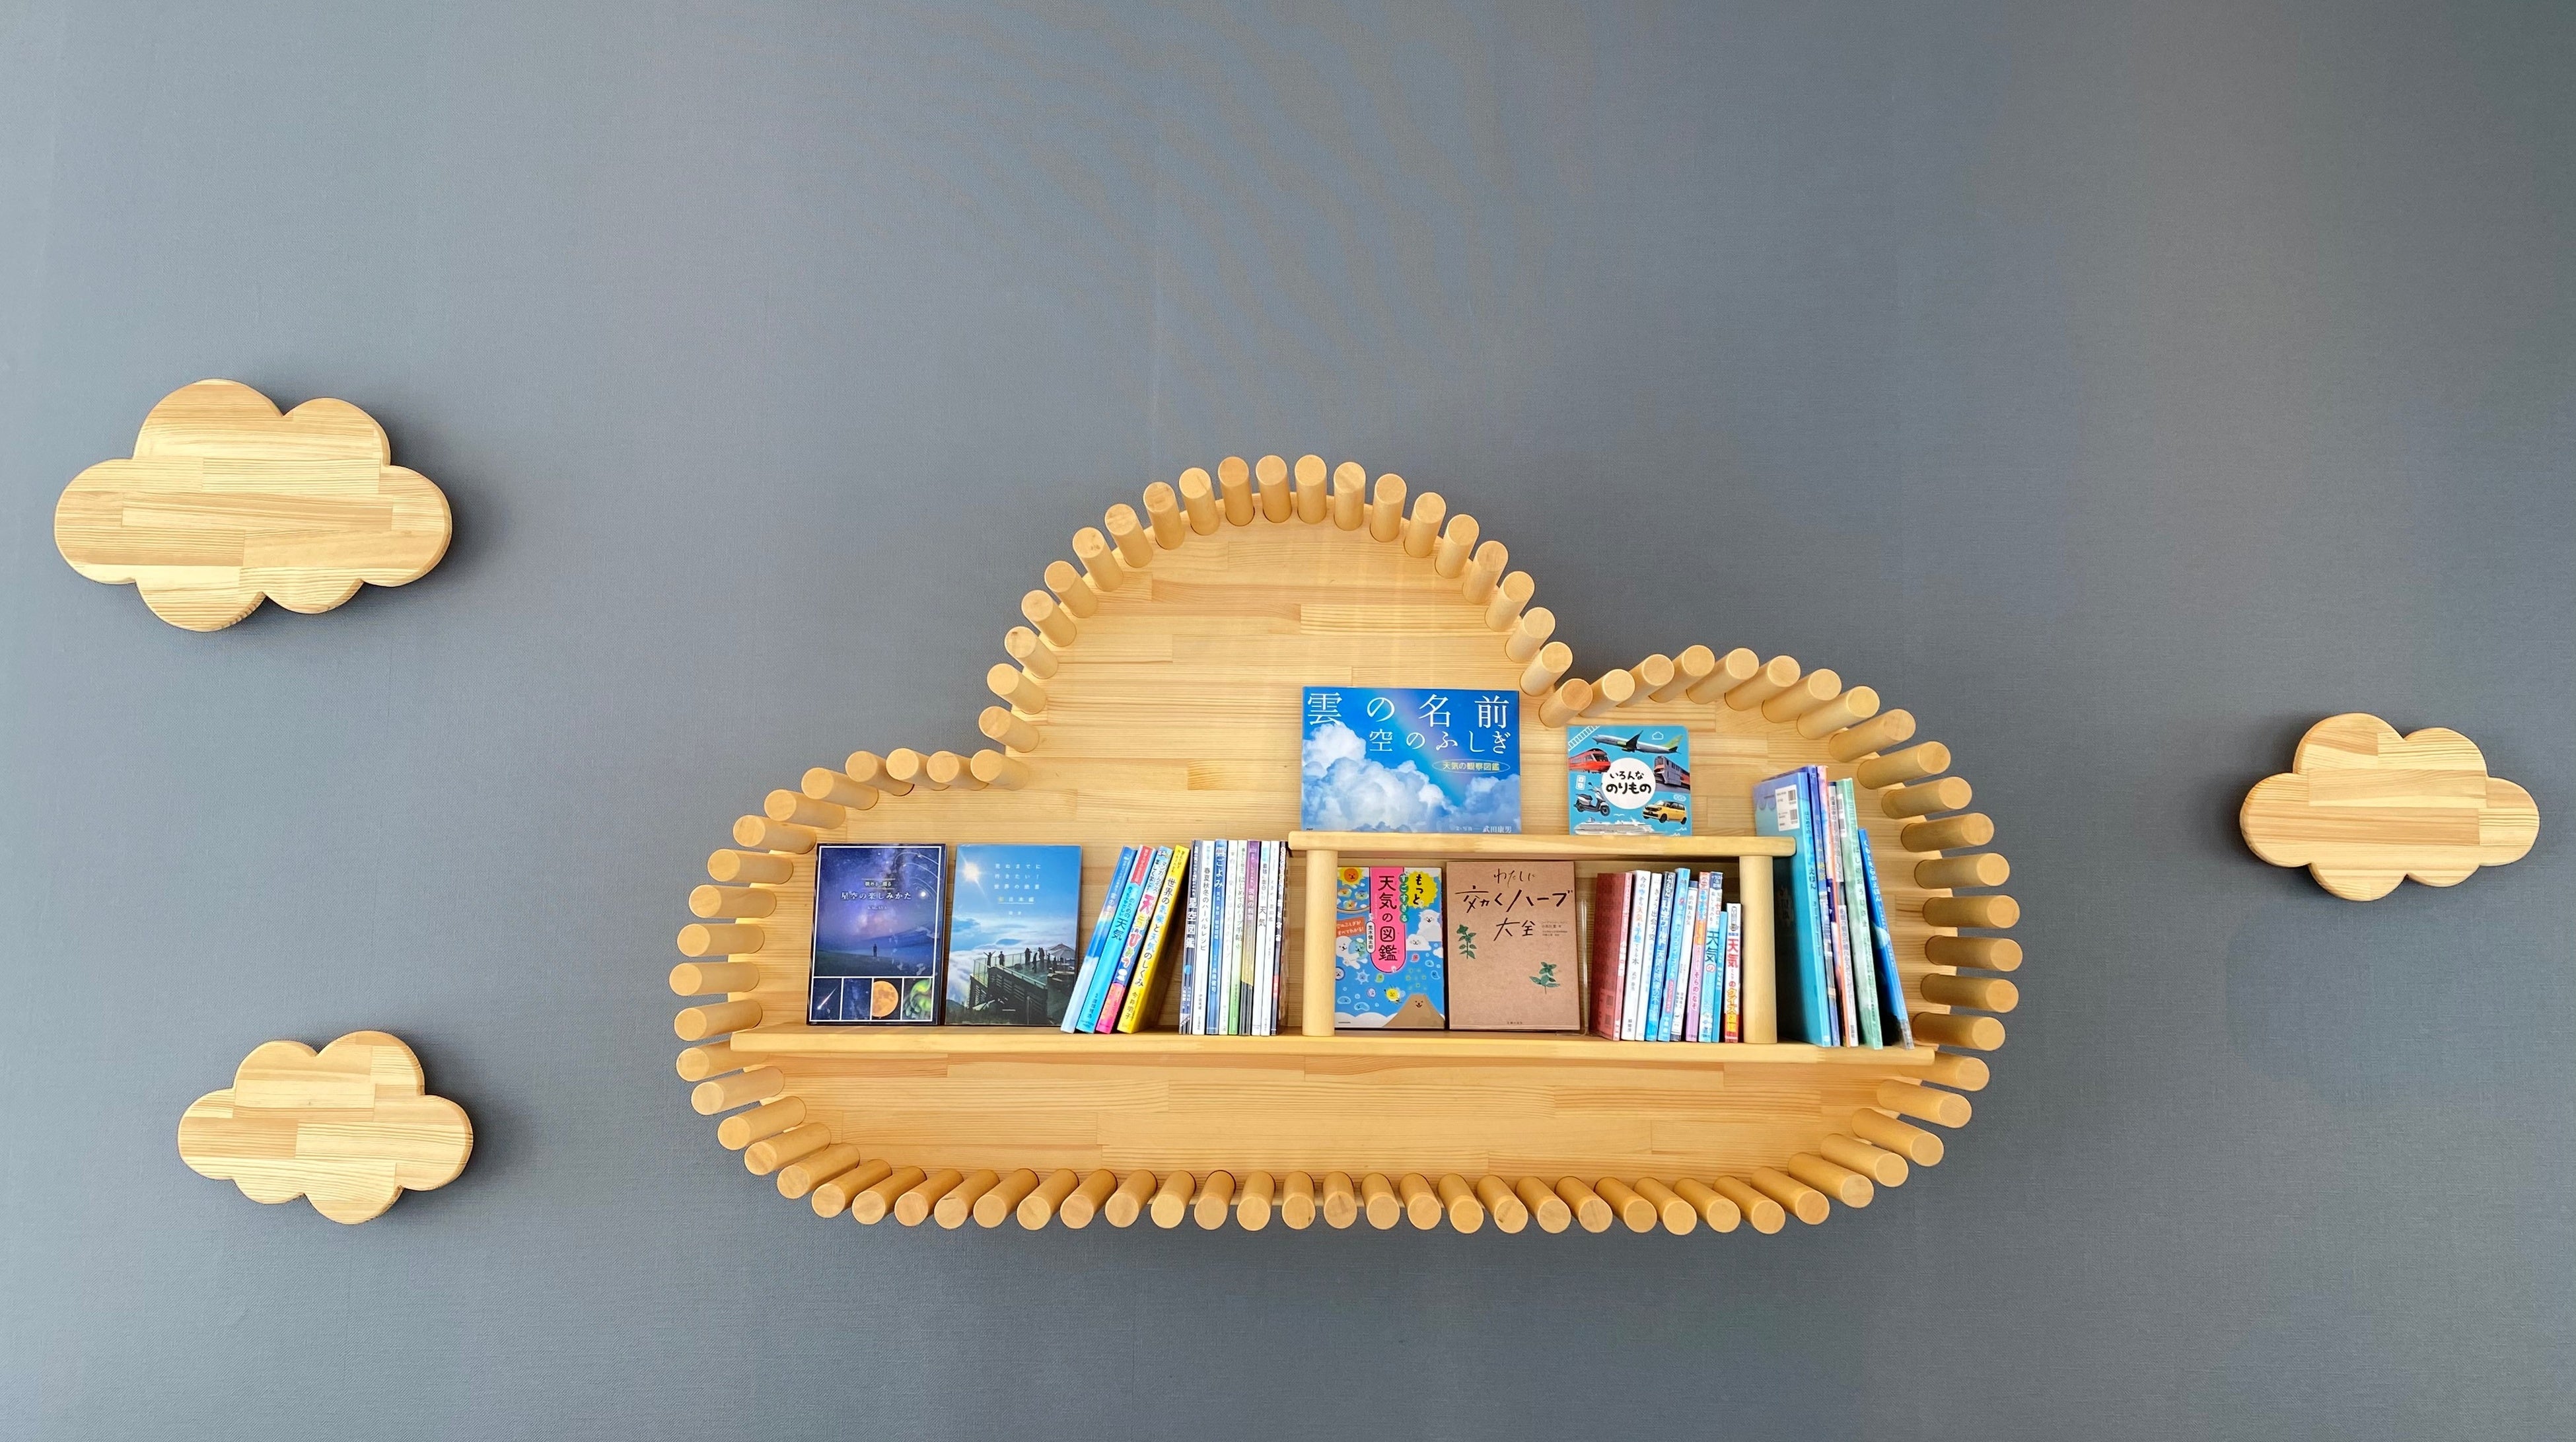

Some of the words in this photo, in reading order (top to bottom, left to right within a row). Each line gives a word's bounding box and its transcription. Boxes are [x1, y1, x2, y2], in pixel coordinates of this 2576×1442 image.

[1307, 692, 1509, 729] 雲の名前
[1369, 729, 1510, 754] 空のふしぎ
[1605, 781, 1651, 795] のりもの
[1610, 770, 1645, 781] いろんな
[1493, 868, 1535, 888] わたしに
[1863, 840, 1881, 902] くもとそらのえほん
[1400, 873, 1409, 923] すごすぎる
[1415, 874, 1424, 905] もっと
[1454, 885, 1573, 914] 効くハーブ
[1186, 897, 1198, 949] 星空図鑑
[1200, 867, 1211, 951] 春夏秋冬のハーバルレシピ
[1258, 906, 1267, 927] 天気
[1378, 875, 1398, 962] 天気の図鑑
[1112, 918, 1128, 941] 天気
[1135, 878, 1176, 987] 世界の気候と天気のしくみ
[1493, 917, 1536, 941] 大全
[1727, 939, 1739, 968] 天気
